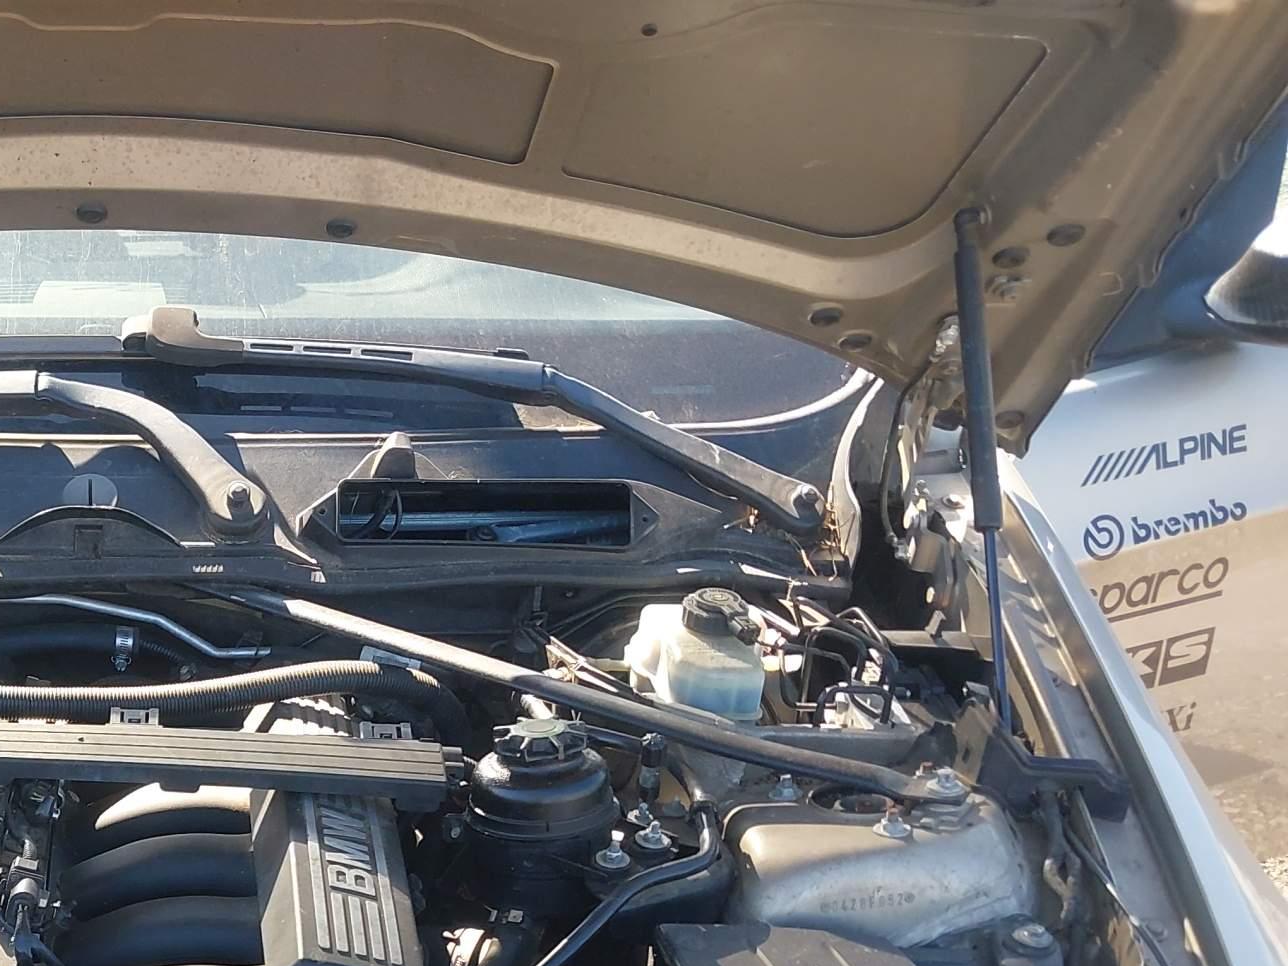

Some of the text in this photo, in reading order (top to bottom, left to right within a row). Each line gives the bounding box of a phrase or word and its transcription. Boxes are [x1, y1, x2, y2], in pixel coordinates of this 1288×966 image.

[1131, 499, 1247, 545] brembo
[1090, 556, 1229, 615] parco
[1126, 632, 1211, 679] KS
[319, 806, 376, 897] BMW
